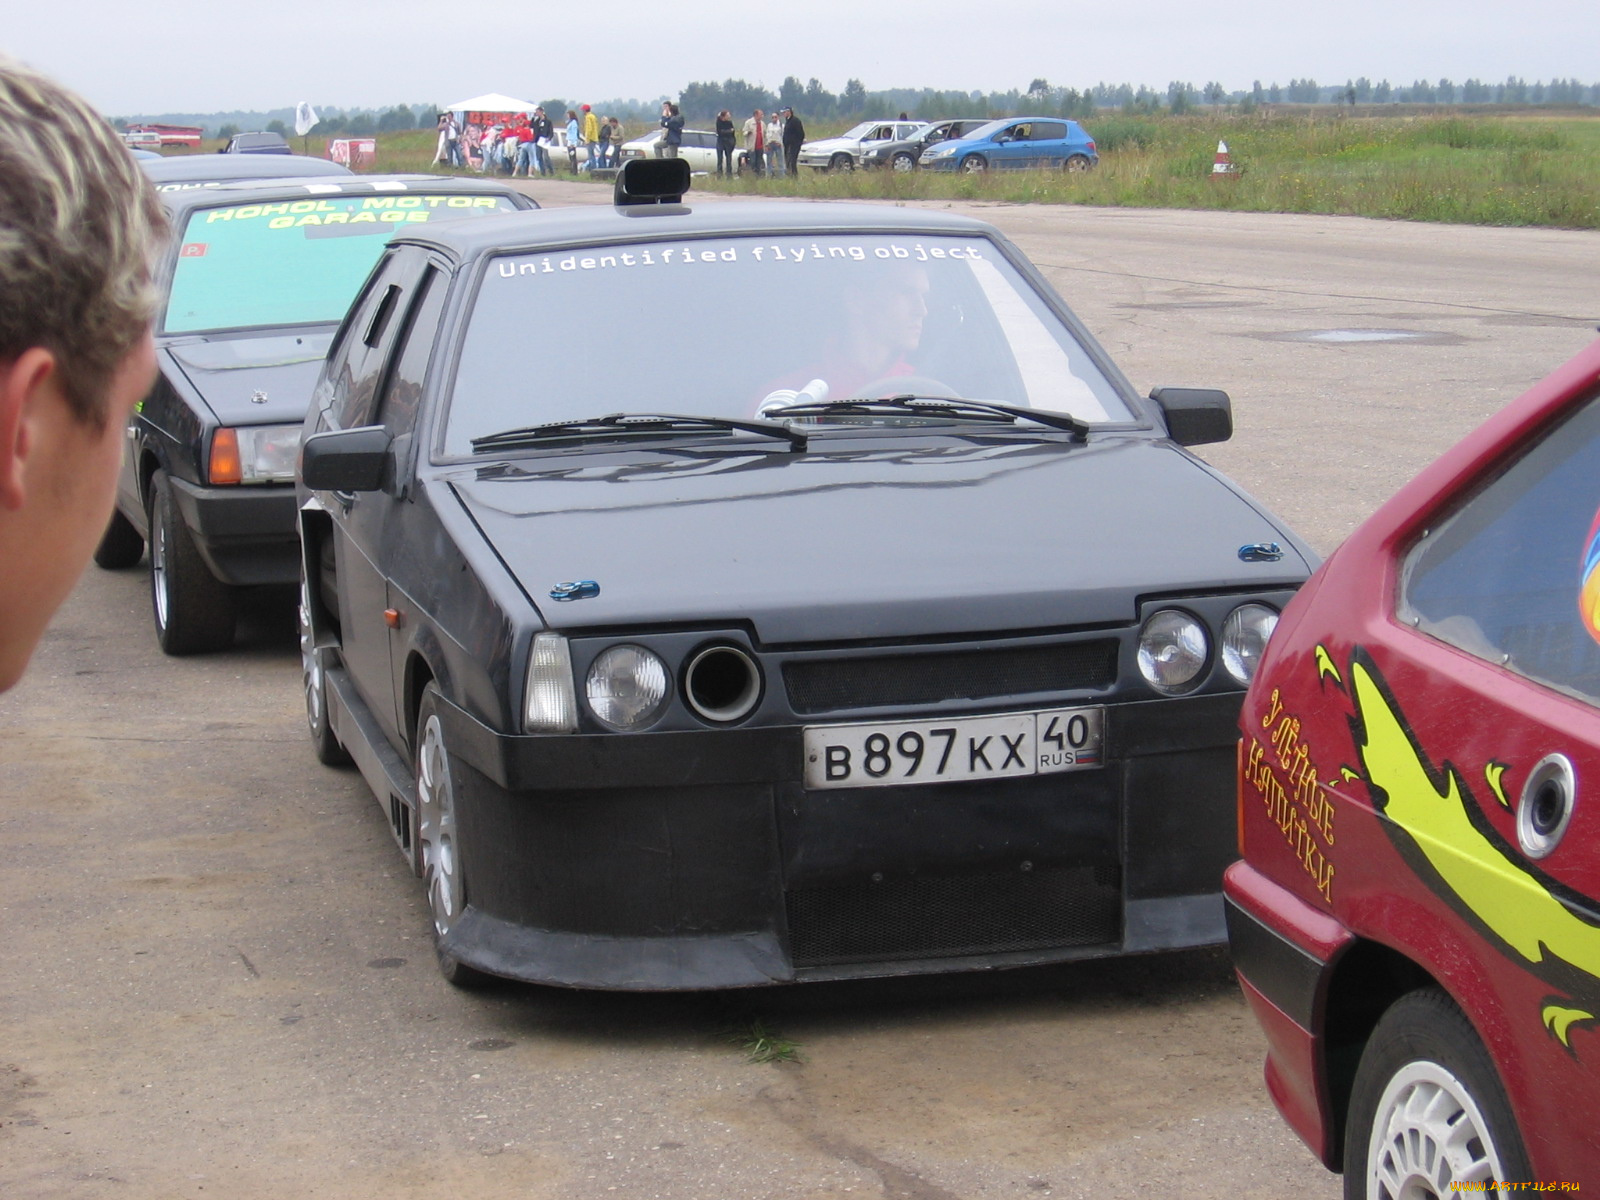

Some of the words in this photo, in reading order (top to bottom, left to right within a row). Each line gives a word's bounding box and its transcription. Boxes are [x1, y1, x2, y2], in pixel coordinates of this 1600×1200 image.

[206, 200, 336, 223] HOHOL
[362, 196, 498, 210] MOTOR
[268, 210, 431, 229] GARAGE
[499, 246, 738, 278] Unidentified
[751, 244, 866, 263] flying
[874, 243, 983, 261] object
[1043, 714, 1090, 750] 40
[1040, 751, 1074, 767] RUS
